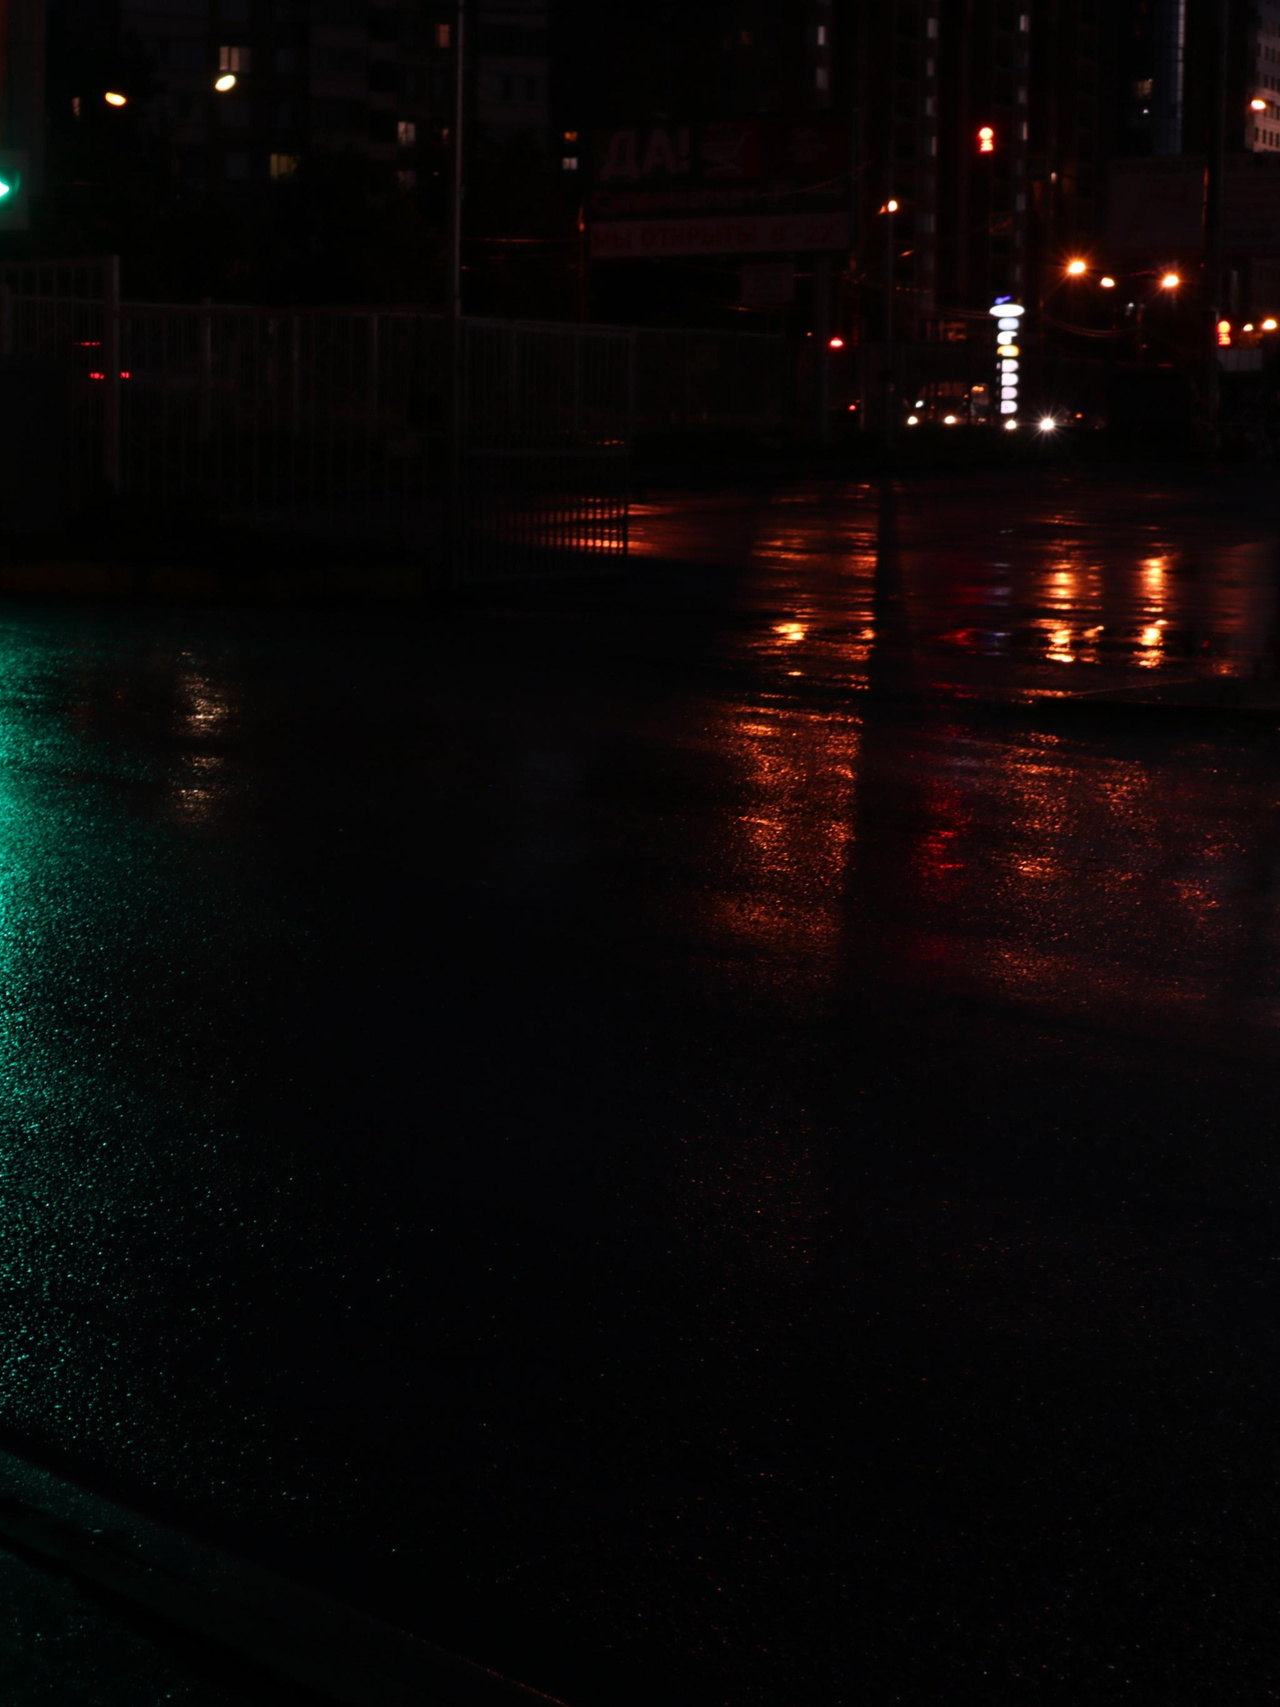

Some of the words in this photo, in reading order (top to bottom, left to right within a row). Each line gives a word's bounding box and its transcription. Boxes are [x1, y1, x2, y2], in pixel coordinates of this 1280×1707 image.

[598, 125, 692, 182] ДА!
[593, 229, 632, 251] МЫ
[640, 225, 759, 248] ОТКРЫТЫ
